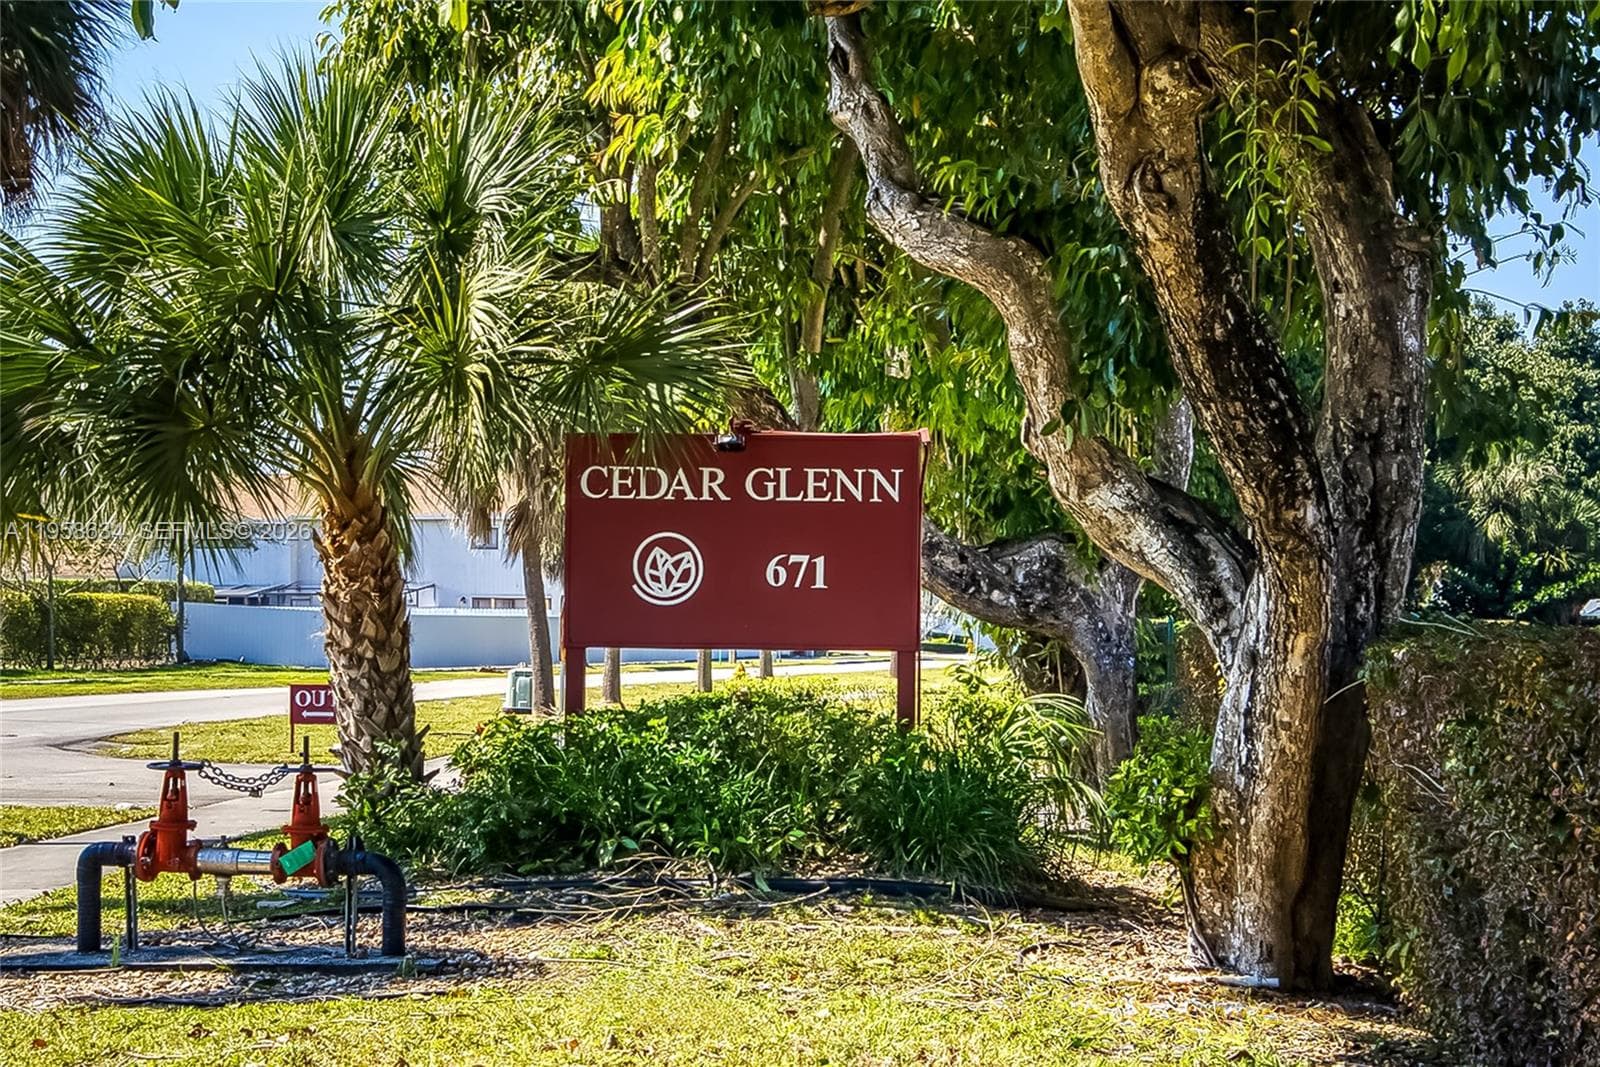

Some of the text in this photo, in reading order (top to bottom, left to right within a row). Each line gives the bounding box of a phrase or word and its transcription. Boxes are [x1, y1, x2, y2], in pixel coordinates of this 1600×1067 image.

[580, 465, 904, 503] CEDAR GLENN
[765, 554, 828, 589] 671
